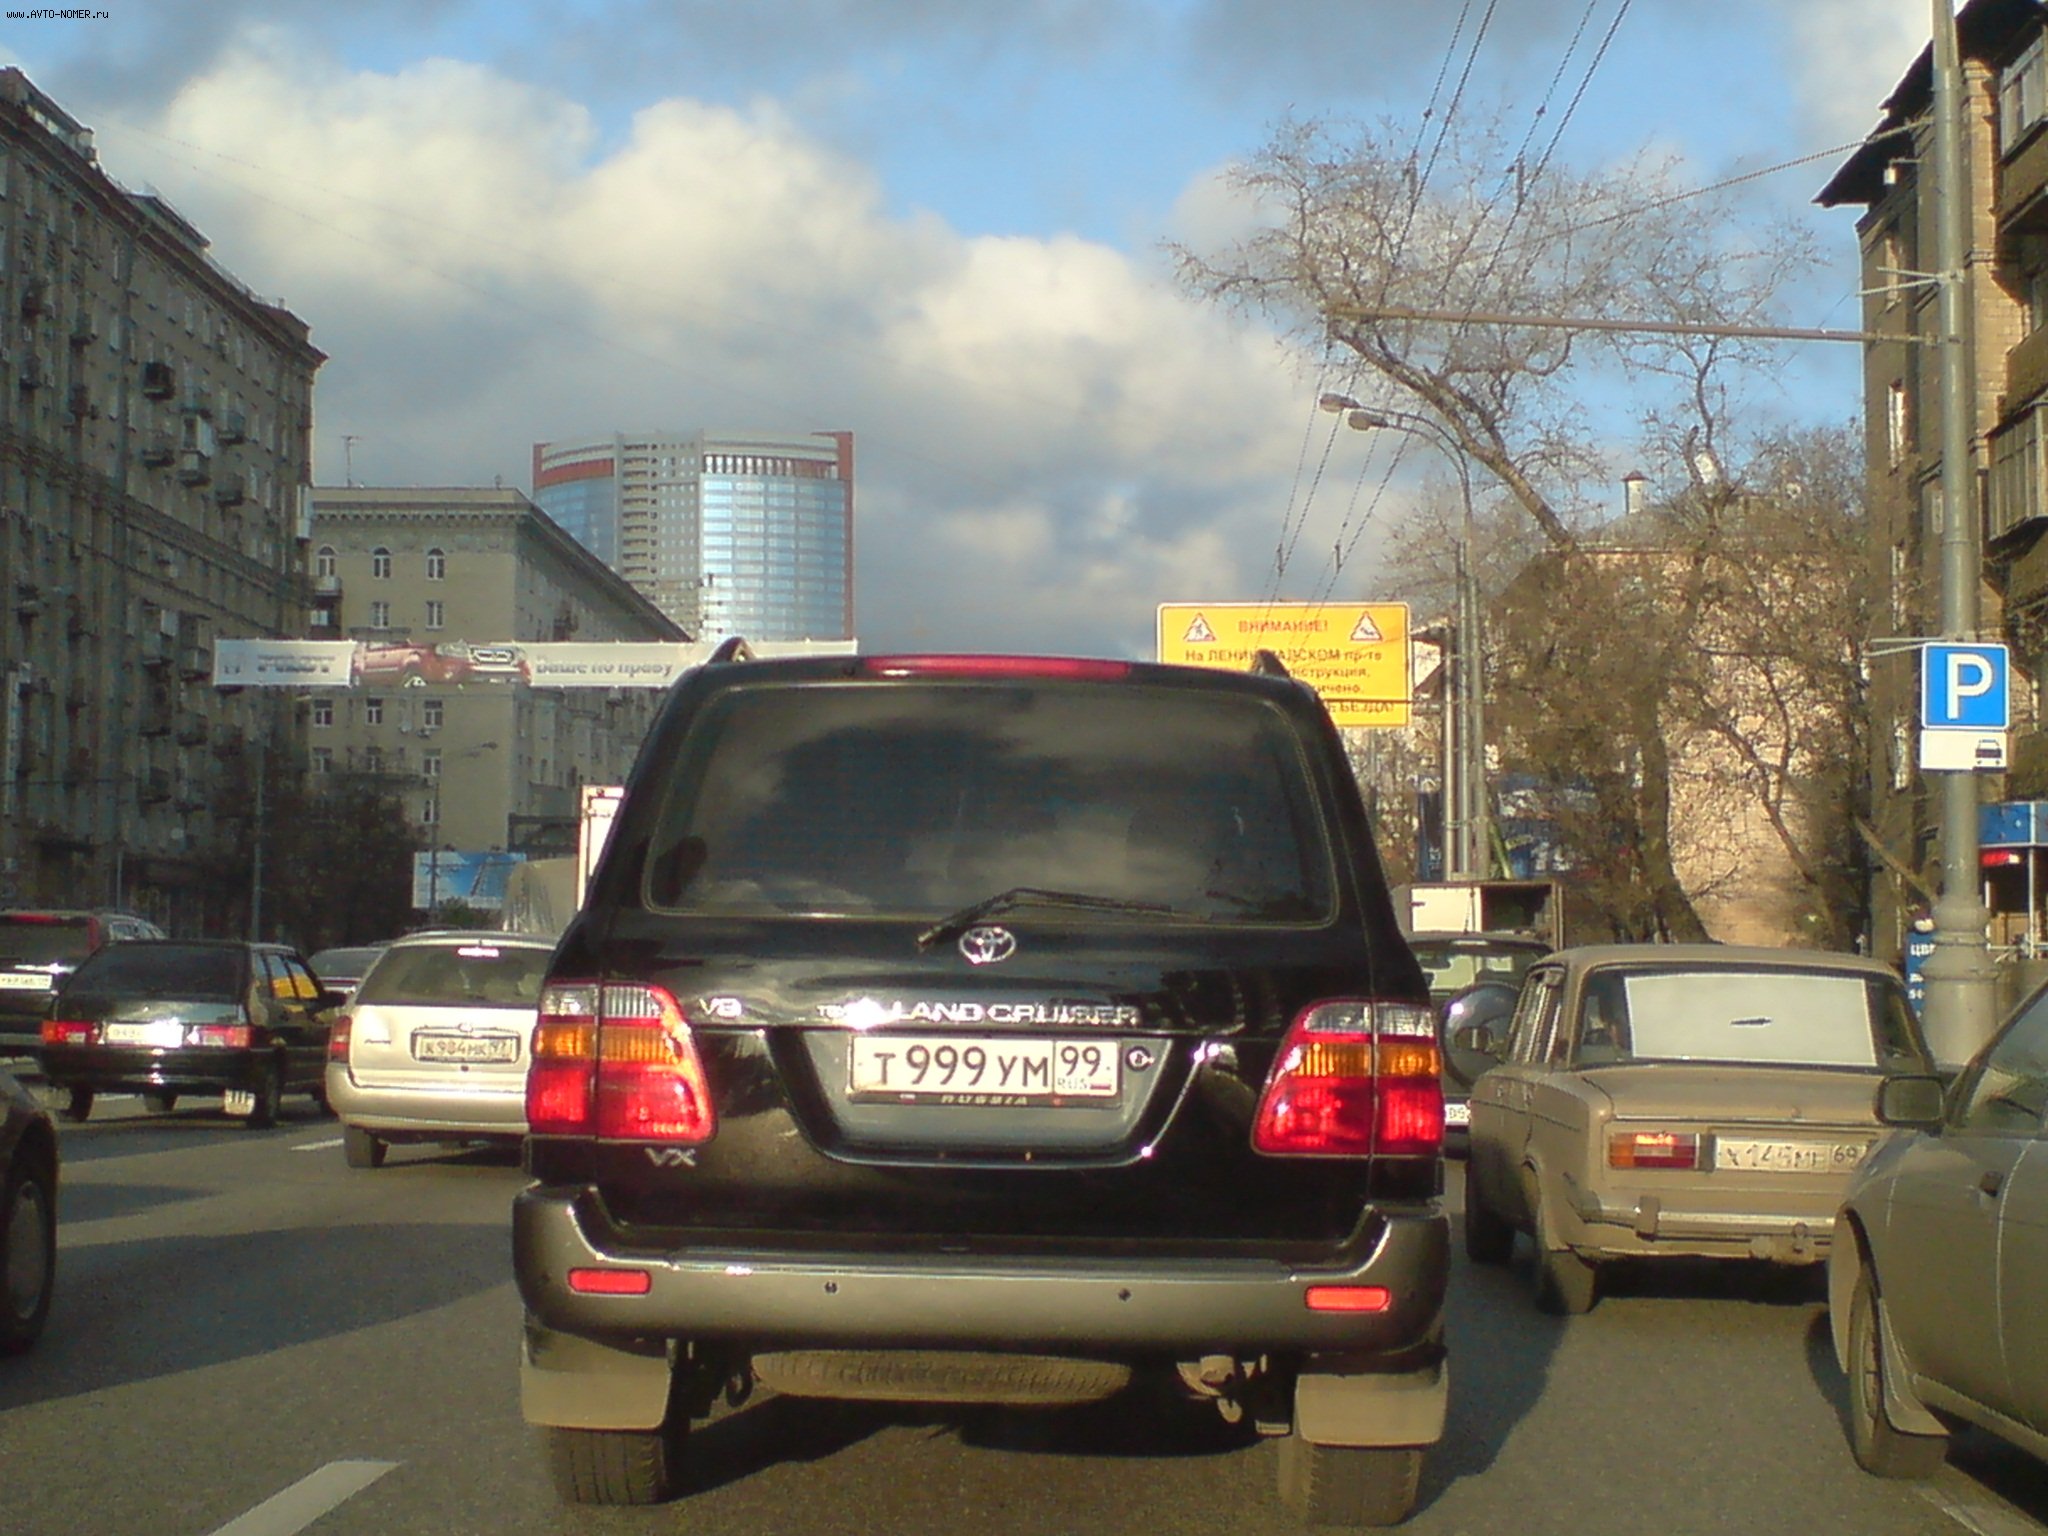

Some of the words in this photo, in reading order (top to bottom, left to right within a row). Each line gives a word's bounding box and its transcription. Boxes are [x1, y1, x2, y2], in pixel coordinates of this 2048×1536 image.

[1238, 619, 1329, 633] ВНИМАНИЕ!
[1185, 649, 1204, 662] На
[1946, 653, 1993, 720] P
[892, 1001, 984, 1022] LAND
[986, 1003, 1140, 1025] CRUISER
[1060, 1045, 1101, 1077] 99
[643, 1147, 697, 1167] VX
